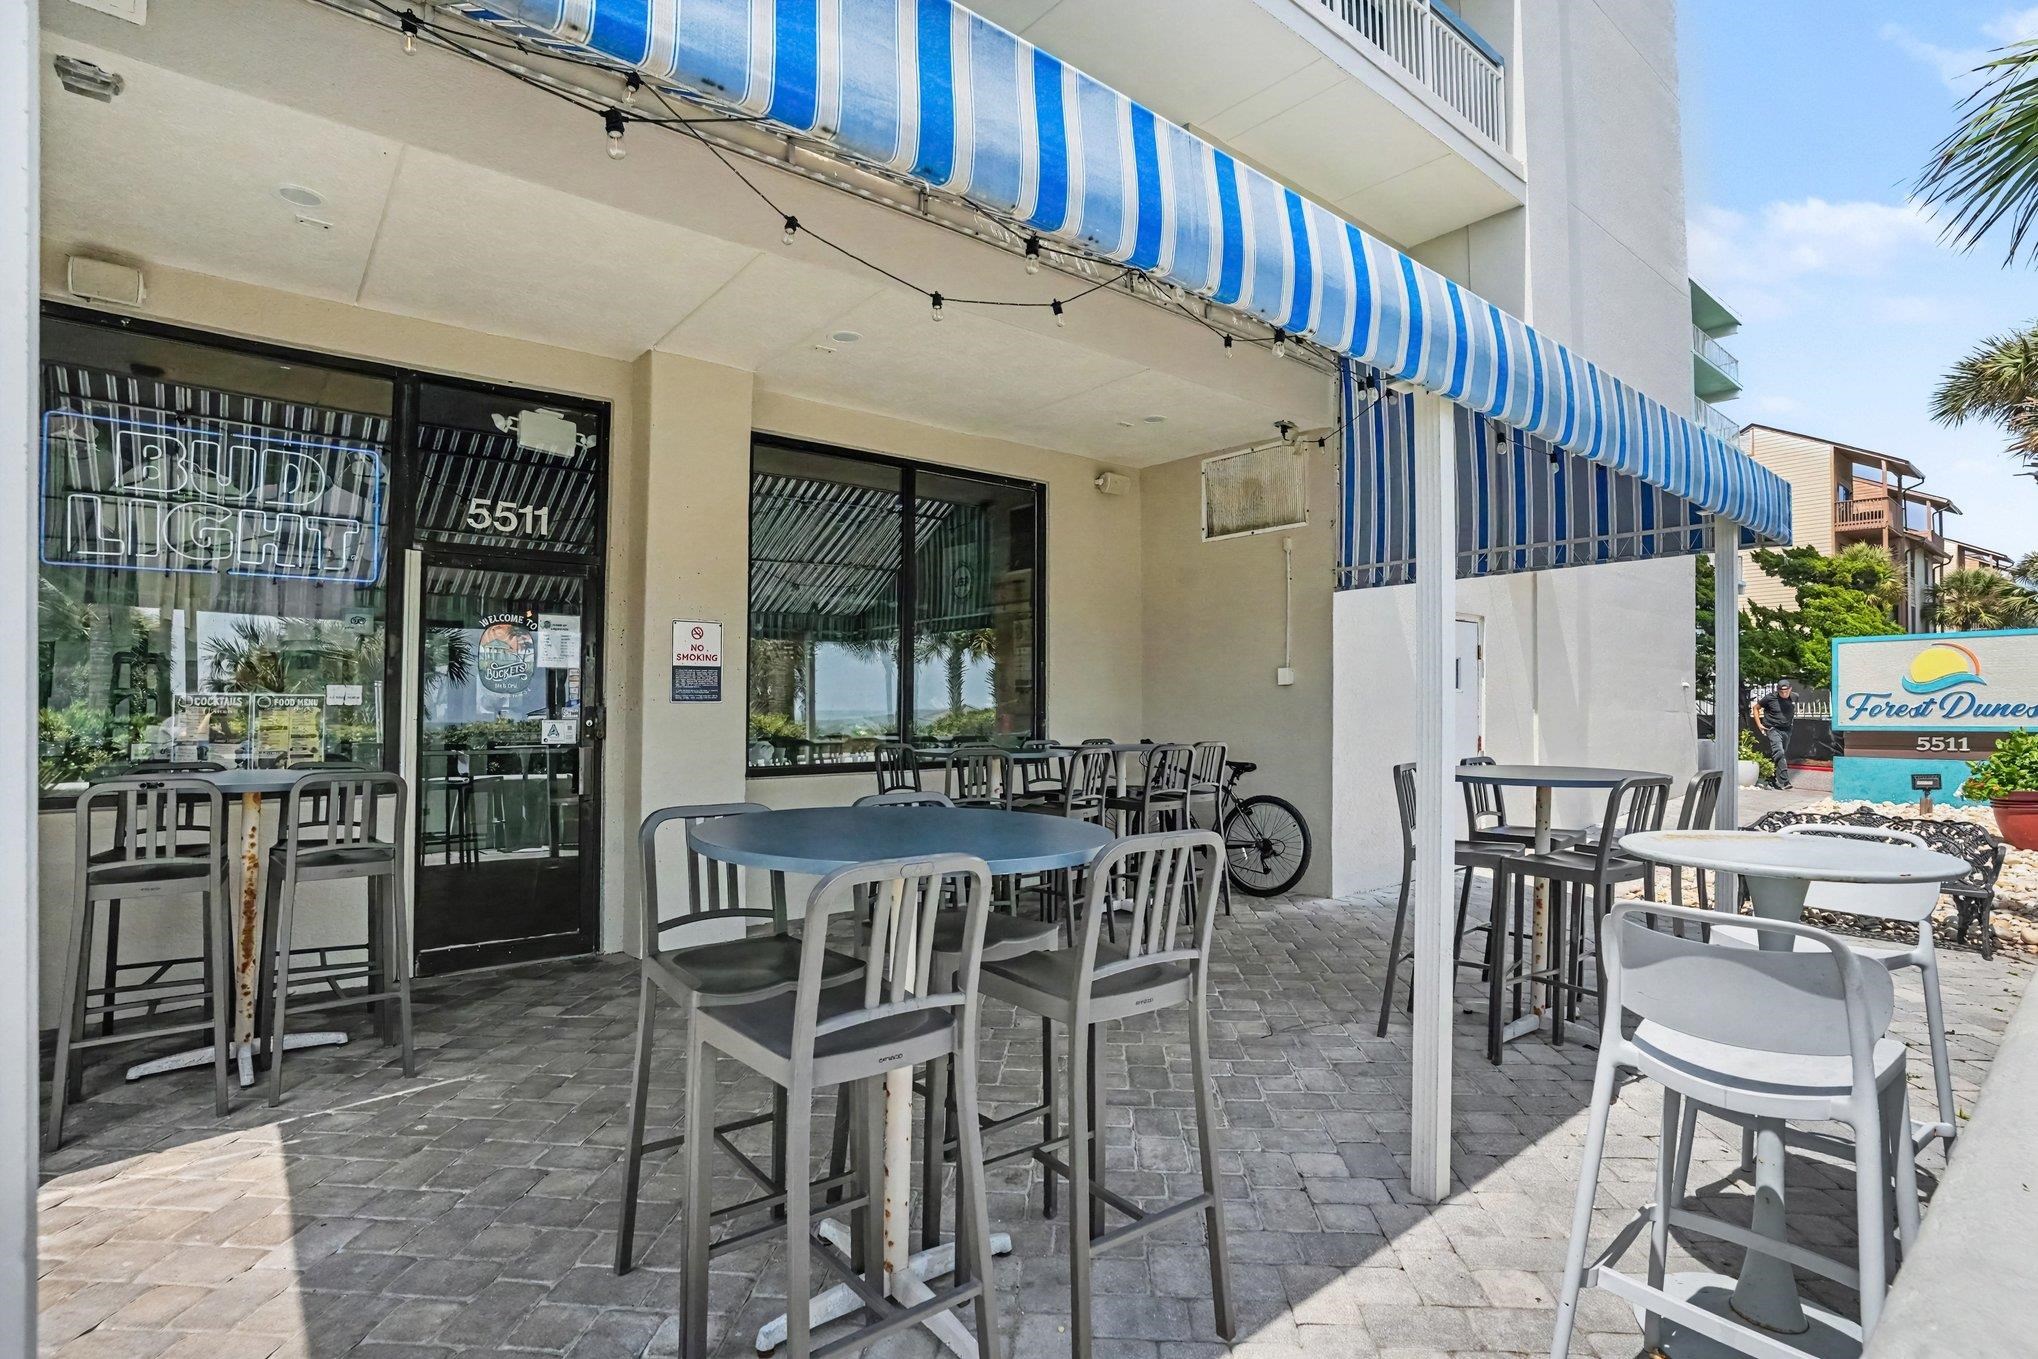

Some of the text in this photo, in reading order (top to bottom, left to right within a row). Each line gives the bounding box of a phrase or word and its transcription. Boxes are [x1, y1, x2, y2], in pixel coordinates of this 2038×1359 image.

[115, 430, 326, 506] BUD
[466, 497, 549, 536] 5511
[67, 492, 360, 571] LIGHT
[478, 613, 525, 628] WELCOME
[526, 618, 539, 631] TO
[690, 644, 705, 652] NO
[676, 653, 718, 662] SMOKING
[485, 664, 526, 681] BUCKETS
[193, 695, 243, 707] COCKTAILS
[273, 698, 319, 707] FOOD MENU
[1845, 690, 2038, 721] Forest Dunes
[1915, 736, 1971, 753] 5511
